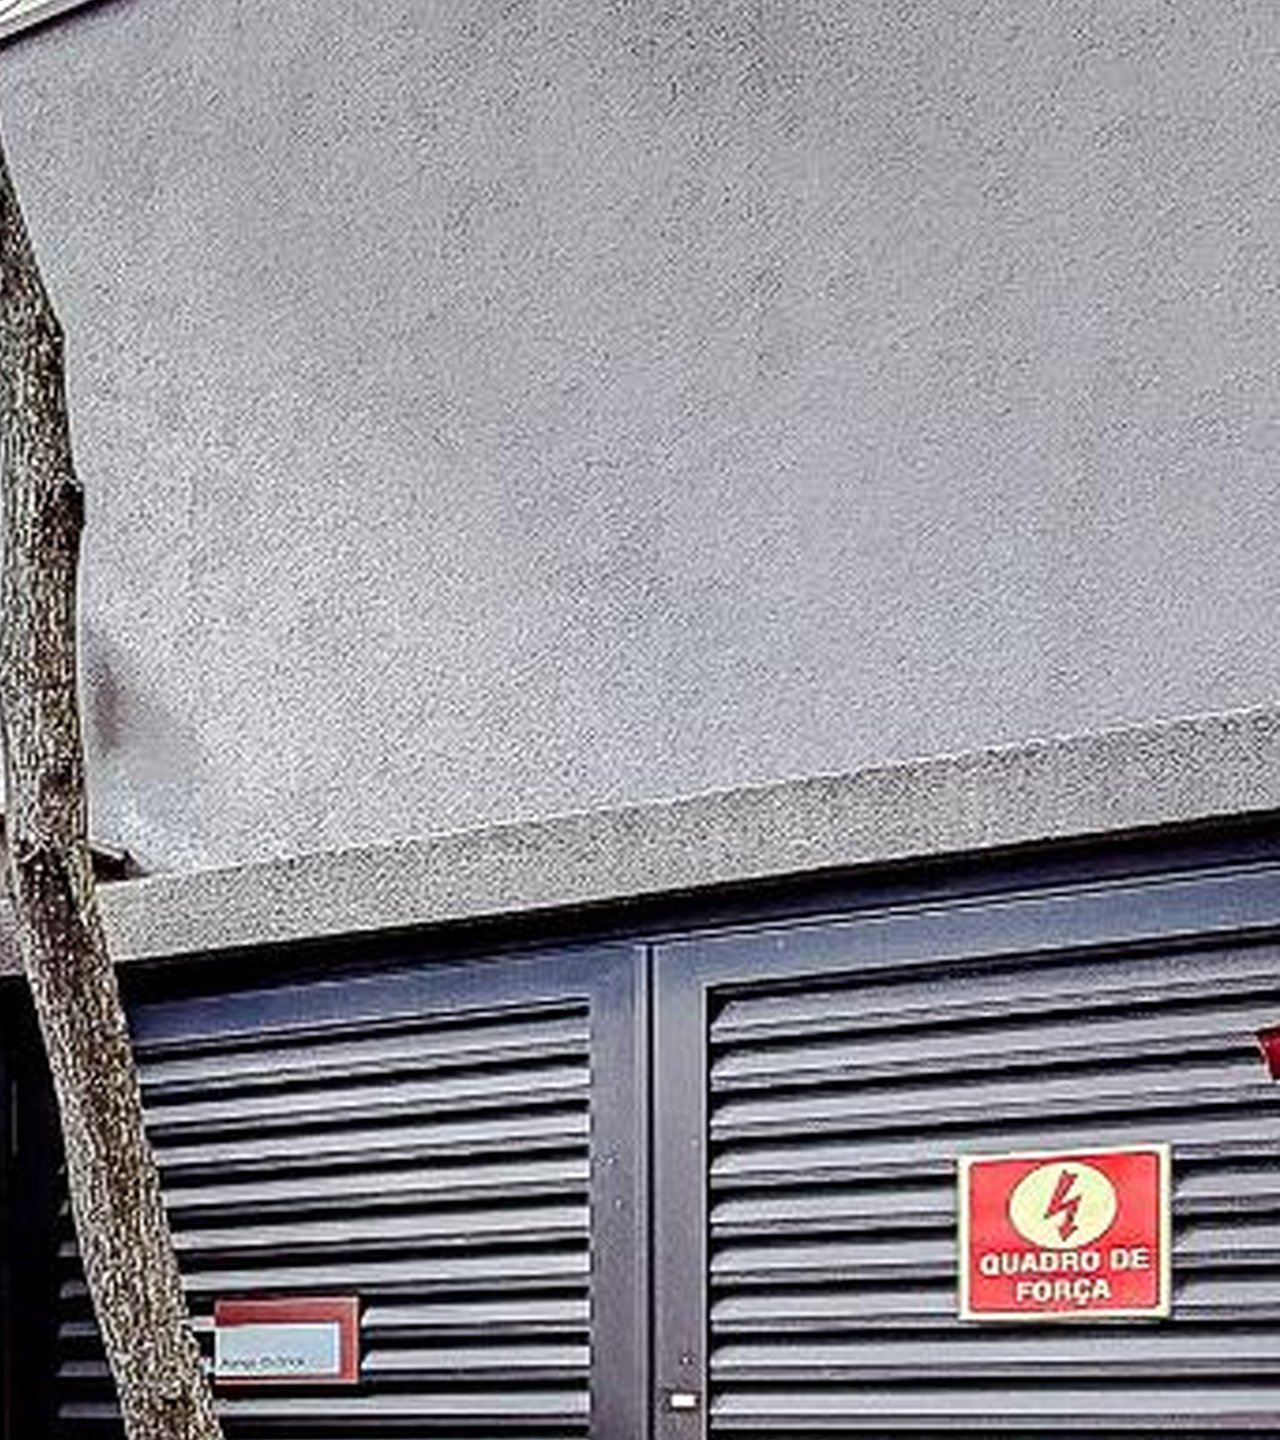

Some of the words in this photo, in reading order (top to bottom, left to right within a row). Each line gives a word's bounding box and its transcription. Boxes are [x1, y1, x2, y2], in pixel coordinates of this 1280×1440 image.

[979, 1251, 1102, 1275] QUADRO
[1110, 1248, 1151, 1270] DE
[1015, 1279, 1112, 1305] FORÇA
